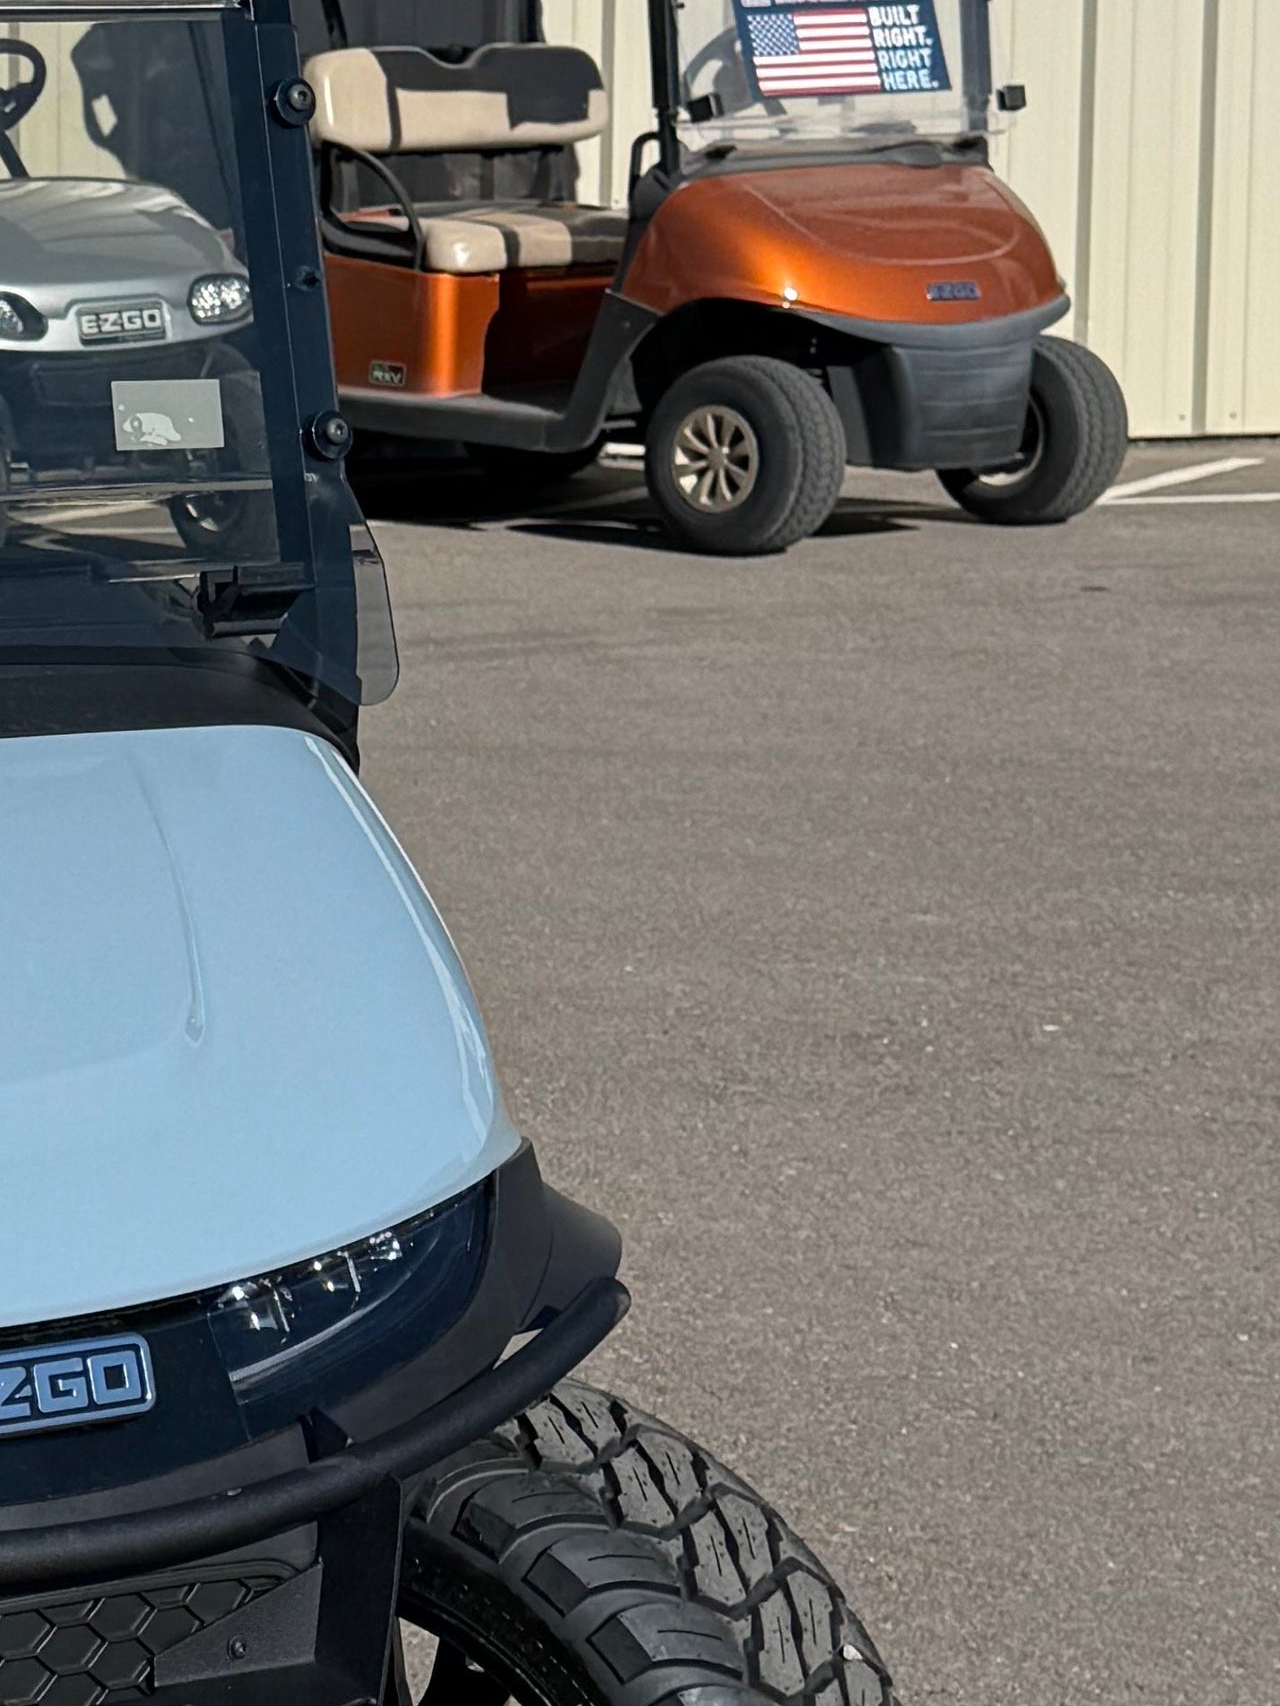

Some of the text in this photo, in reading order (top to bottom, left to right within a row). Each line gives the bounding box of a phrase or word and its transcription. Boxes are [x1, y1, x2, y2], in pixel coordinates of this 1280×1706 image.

[868, 5, 920, 26] BUILT
[872, 26, 933, 47] RIGHT.
[877, 49, 932, 69] RIGHT
[882, 70, 939, 90] HERE.
[81, 309, 162, 334] EZGO
